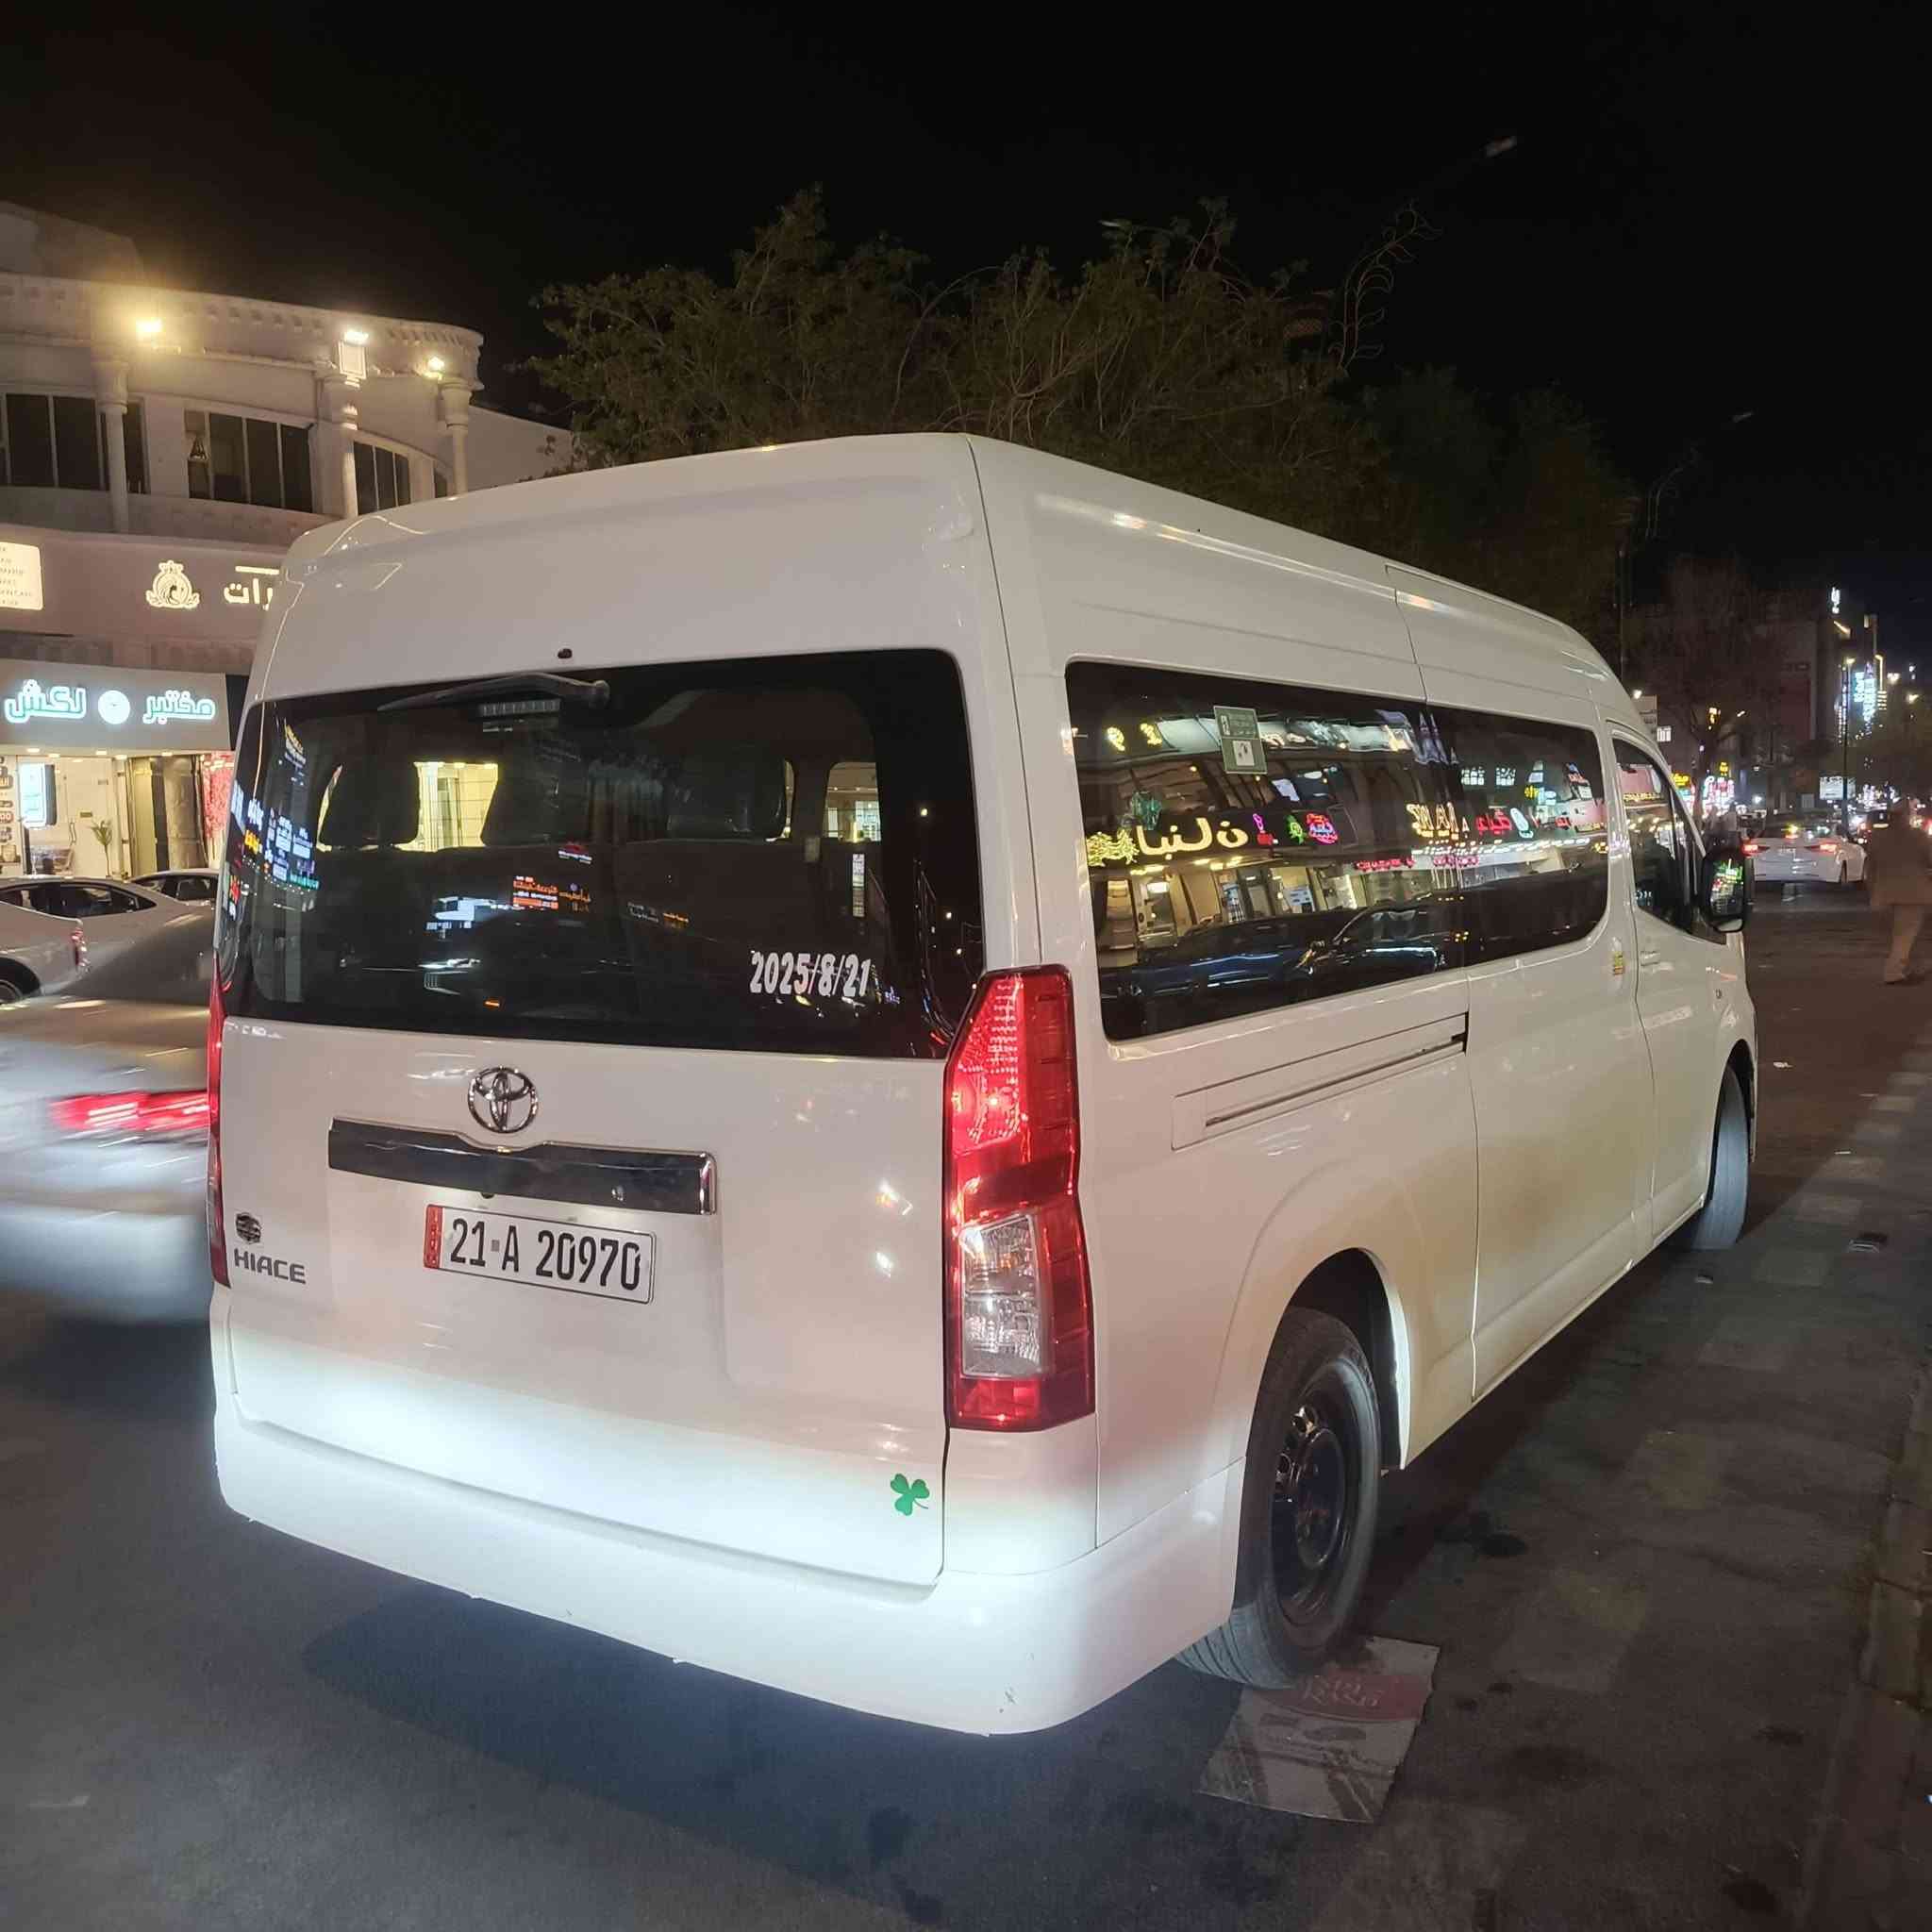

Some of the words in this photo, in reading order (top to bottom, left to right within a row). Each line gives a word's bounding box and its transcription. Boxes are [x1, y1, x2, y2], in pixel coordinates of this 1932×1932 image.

[4, 678, 87, 724] لكش
[142, 690, 216, 724] مختبر
[749, 951, 872, 998] 2025/8/21
[233, 1247, 307, 1285] HIACE
[535, 1229, 641, 1291] 20970
